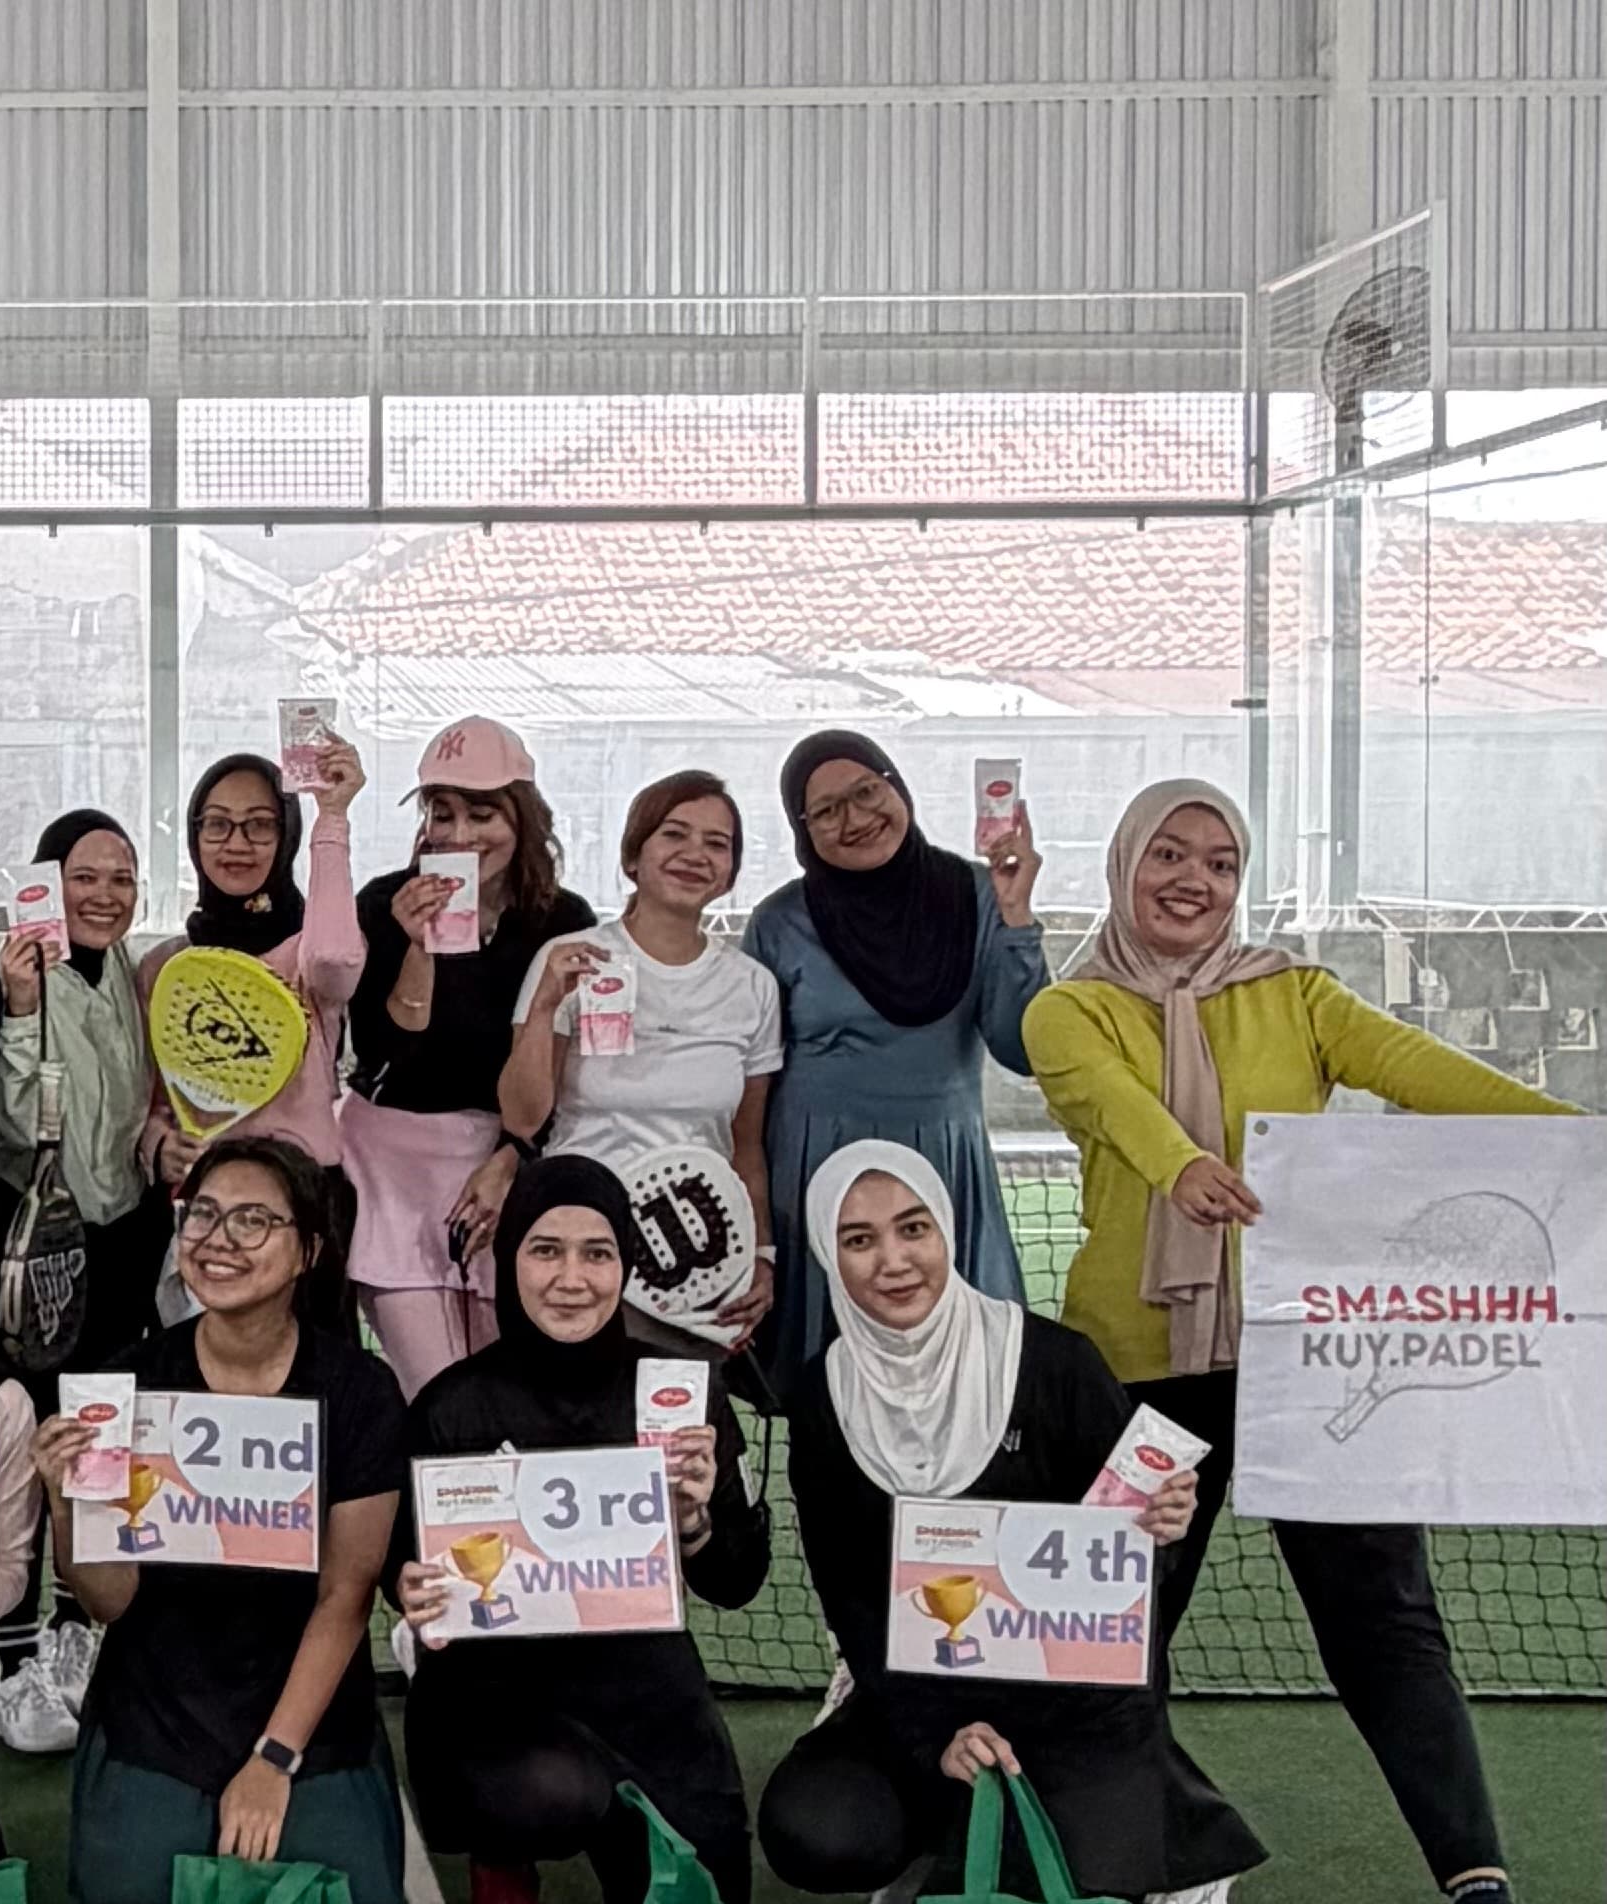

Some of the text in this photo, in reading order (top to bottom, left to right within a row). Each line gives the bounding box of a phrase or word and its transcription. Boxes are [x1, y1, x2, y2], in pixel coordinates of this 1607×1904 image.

[1301, 1284, 1576, 1324] SMASHHH.
[1301, 1332, 1542, 1370] KUY.PADEL
[162, 1493, 314, 1533] WINNER
[514, 1556, 670, 1594] WINNER
[986, 1607, 1145, 1645] WINNER
